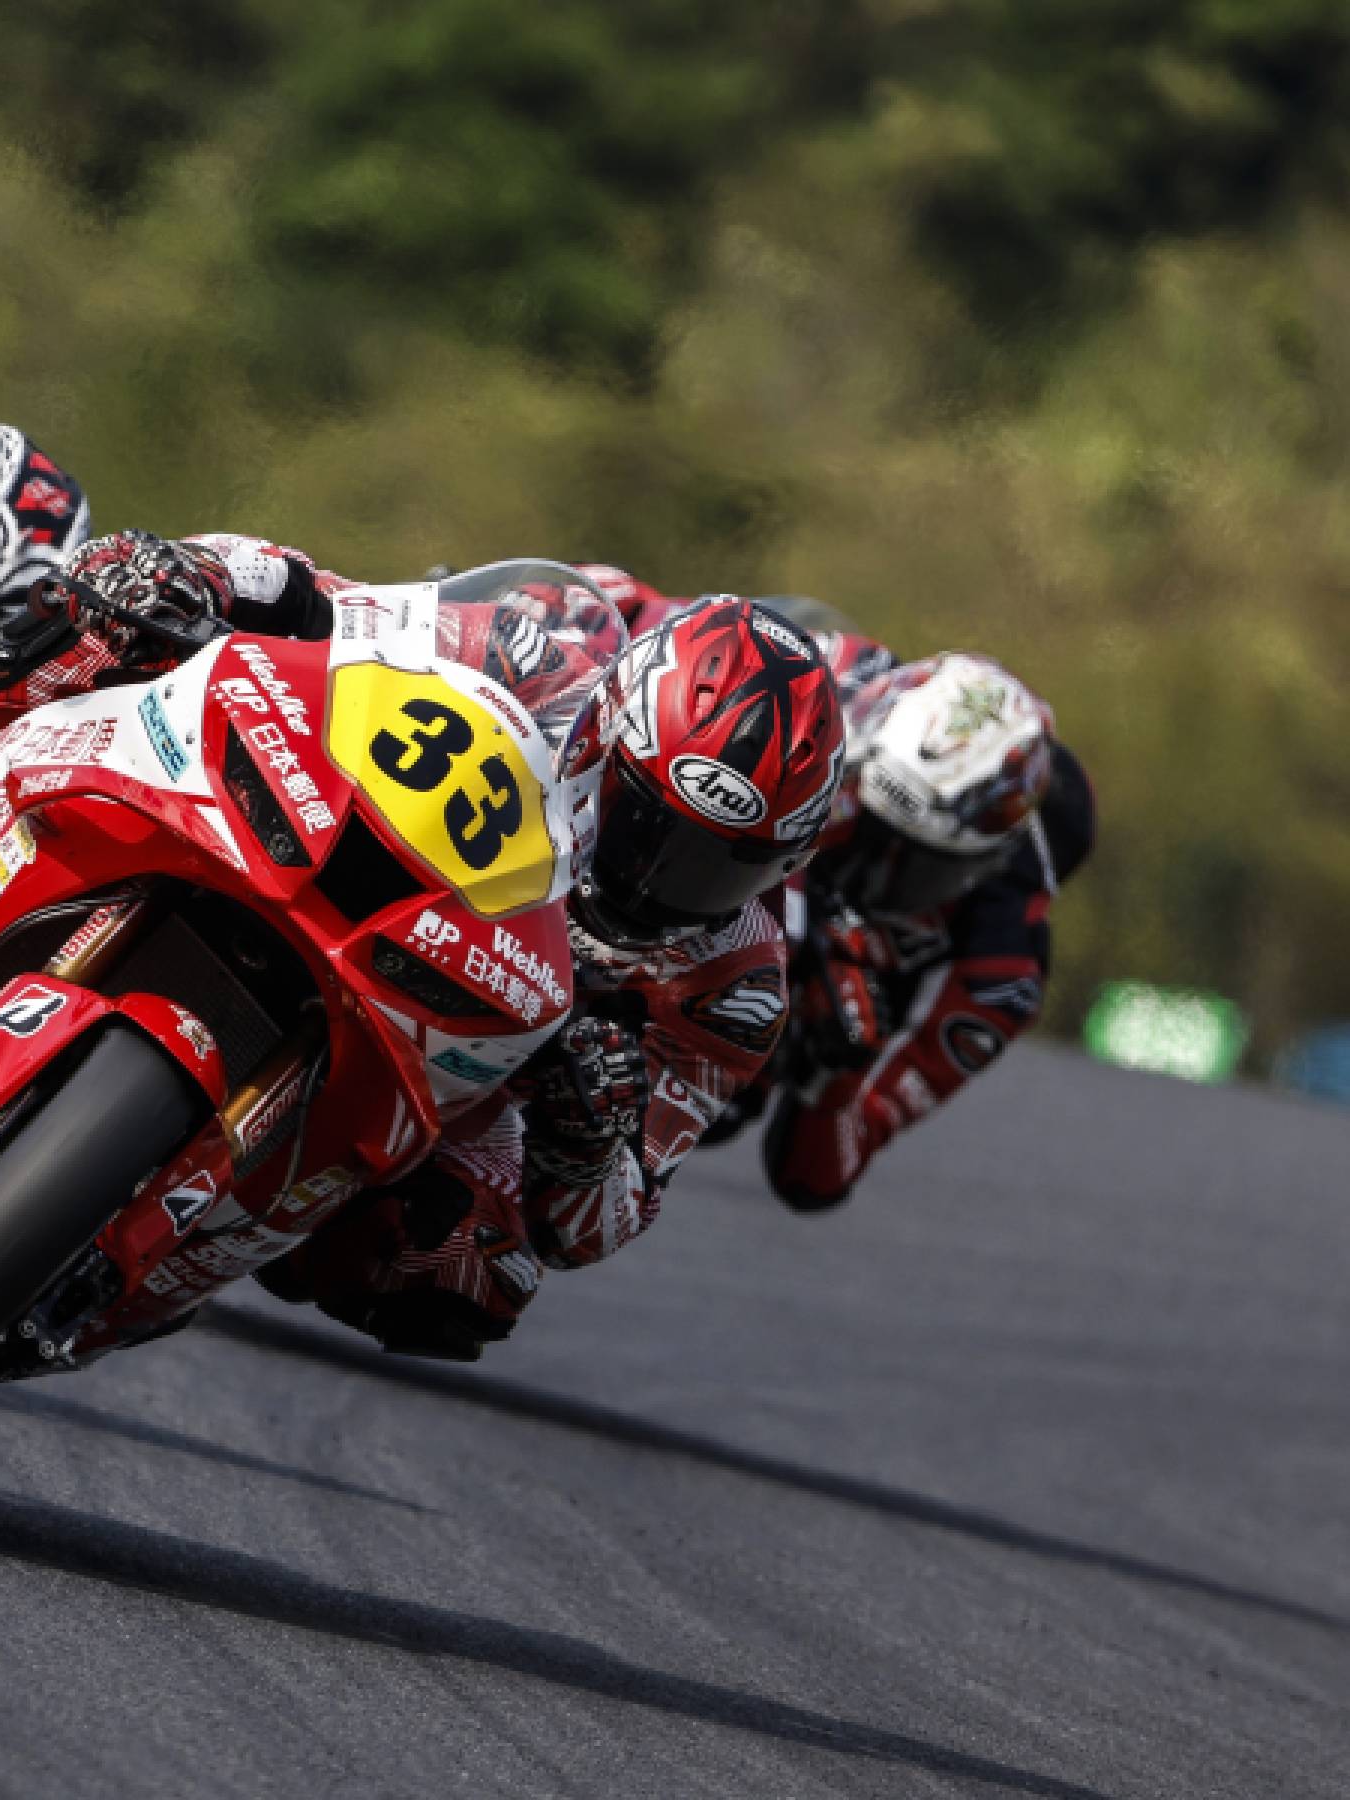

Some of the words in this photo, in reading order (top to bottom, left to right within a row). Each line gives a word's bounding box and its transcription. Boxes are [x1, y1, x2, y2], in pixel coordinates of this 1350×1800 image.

[230, 643, 312, 736] Webike
[248, 722, 337, 835] 日本郵便
[370, 698, 523, 871] 33
[674, 762, 756, 817] Arai
[492, 923, 567, 1008] Webike
